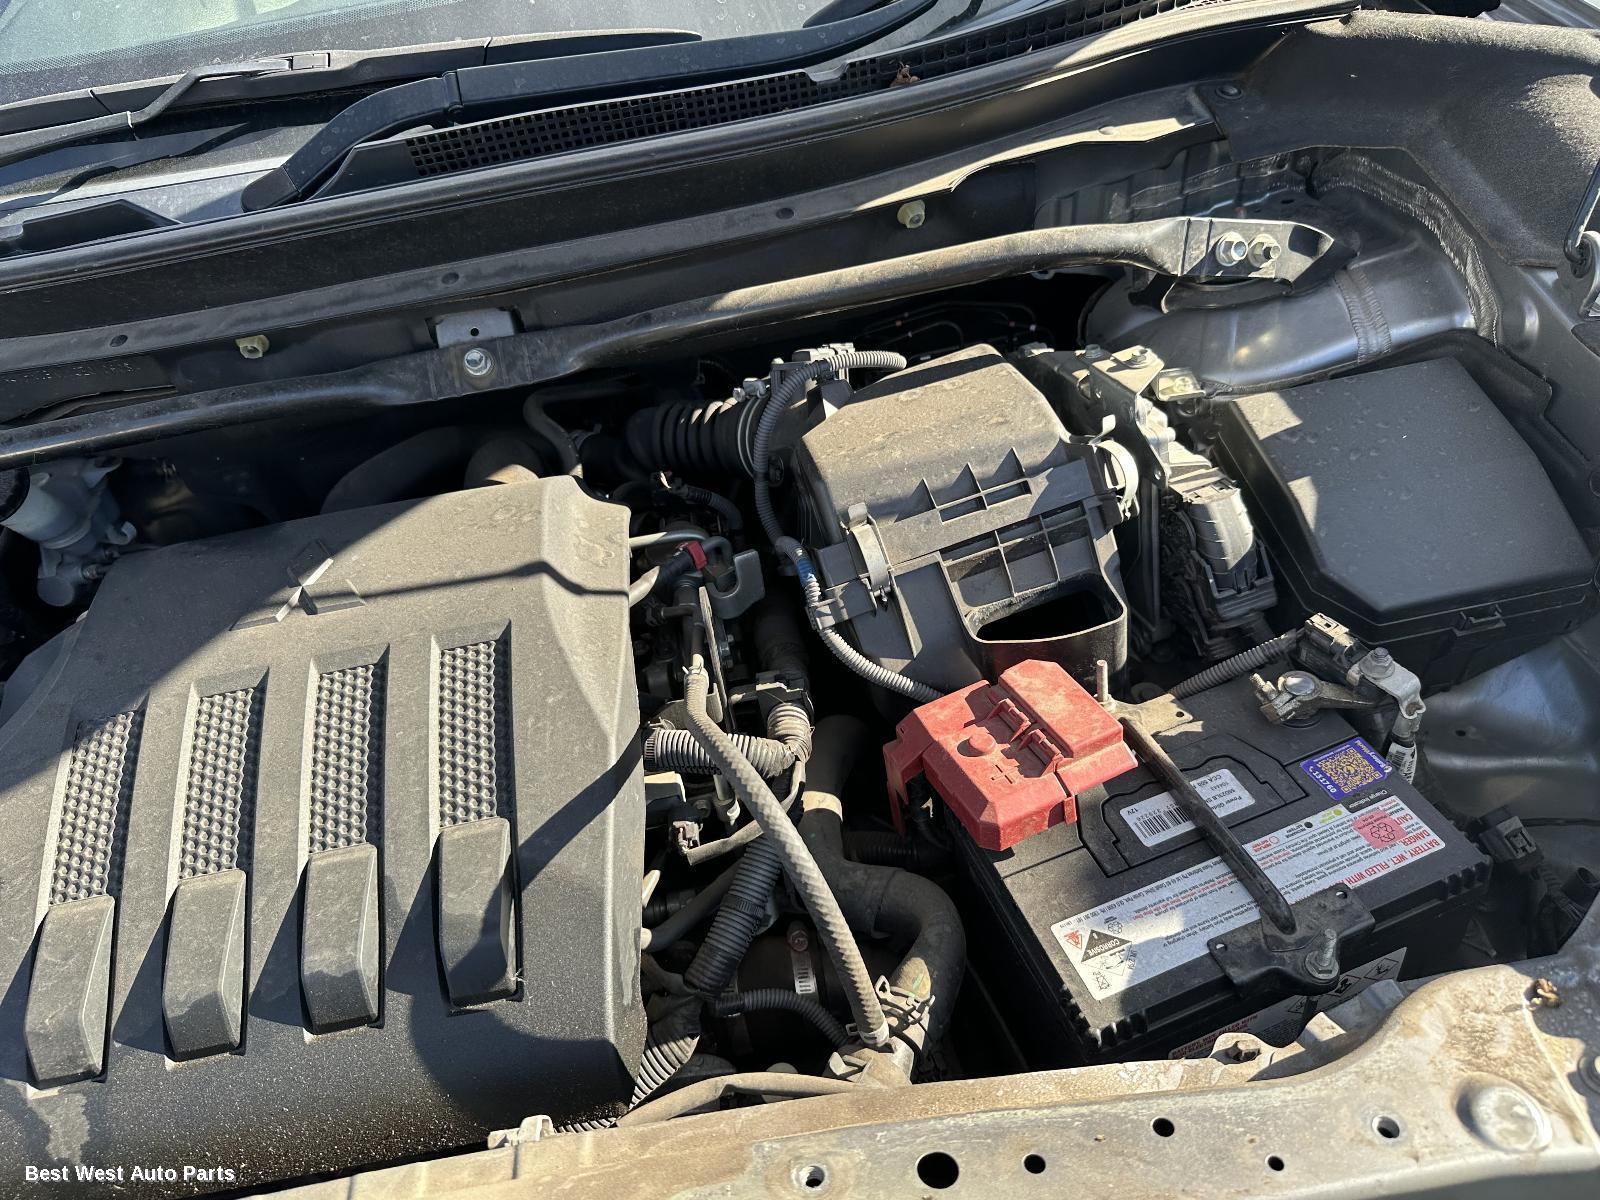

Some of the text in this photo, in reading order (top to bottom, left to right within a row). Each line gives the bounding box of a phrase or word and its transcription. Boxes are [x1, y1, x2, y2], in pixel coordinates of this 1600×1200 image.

[1207, 774, 1221, 782] CCA
[1312, 770, 1337, 793] 131760
[1370, 789, 1387, 798] Charge
[1225, 795, 1241, 805] Power
[1347, 796, 1370, 808] Indicator
[1127, 806, 1139, 815] 12V
[1394, 813, 1413, 825] CAUT
[1364, 860, 1389, 876] FILLED
[1345, 871, 1366, 885] WITH
[1086, 937, 1120, 956] CORROSIVE
